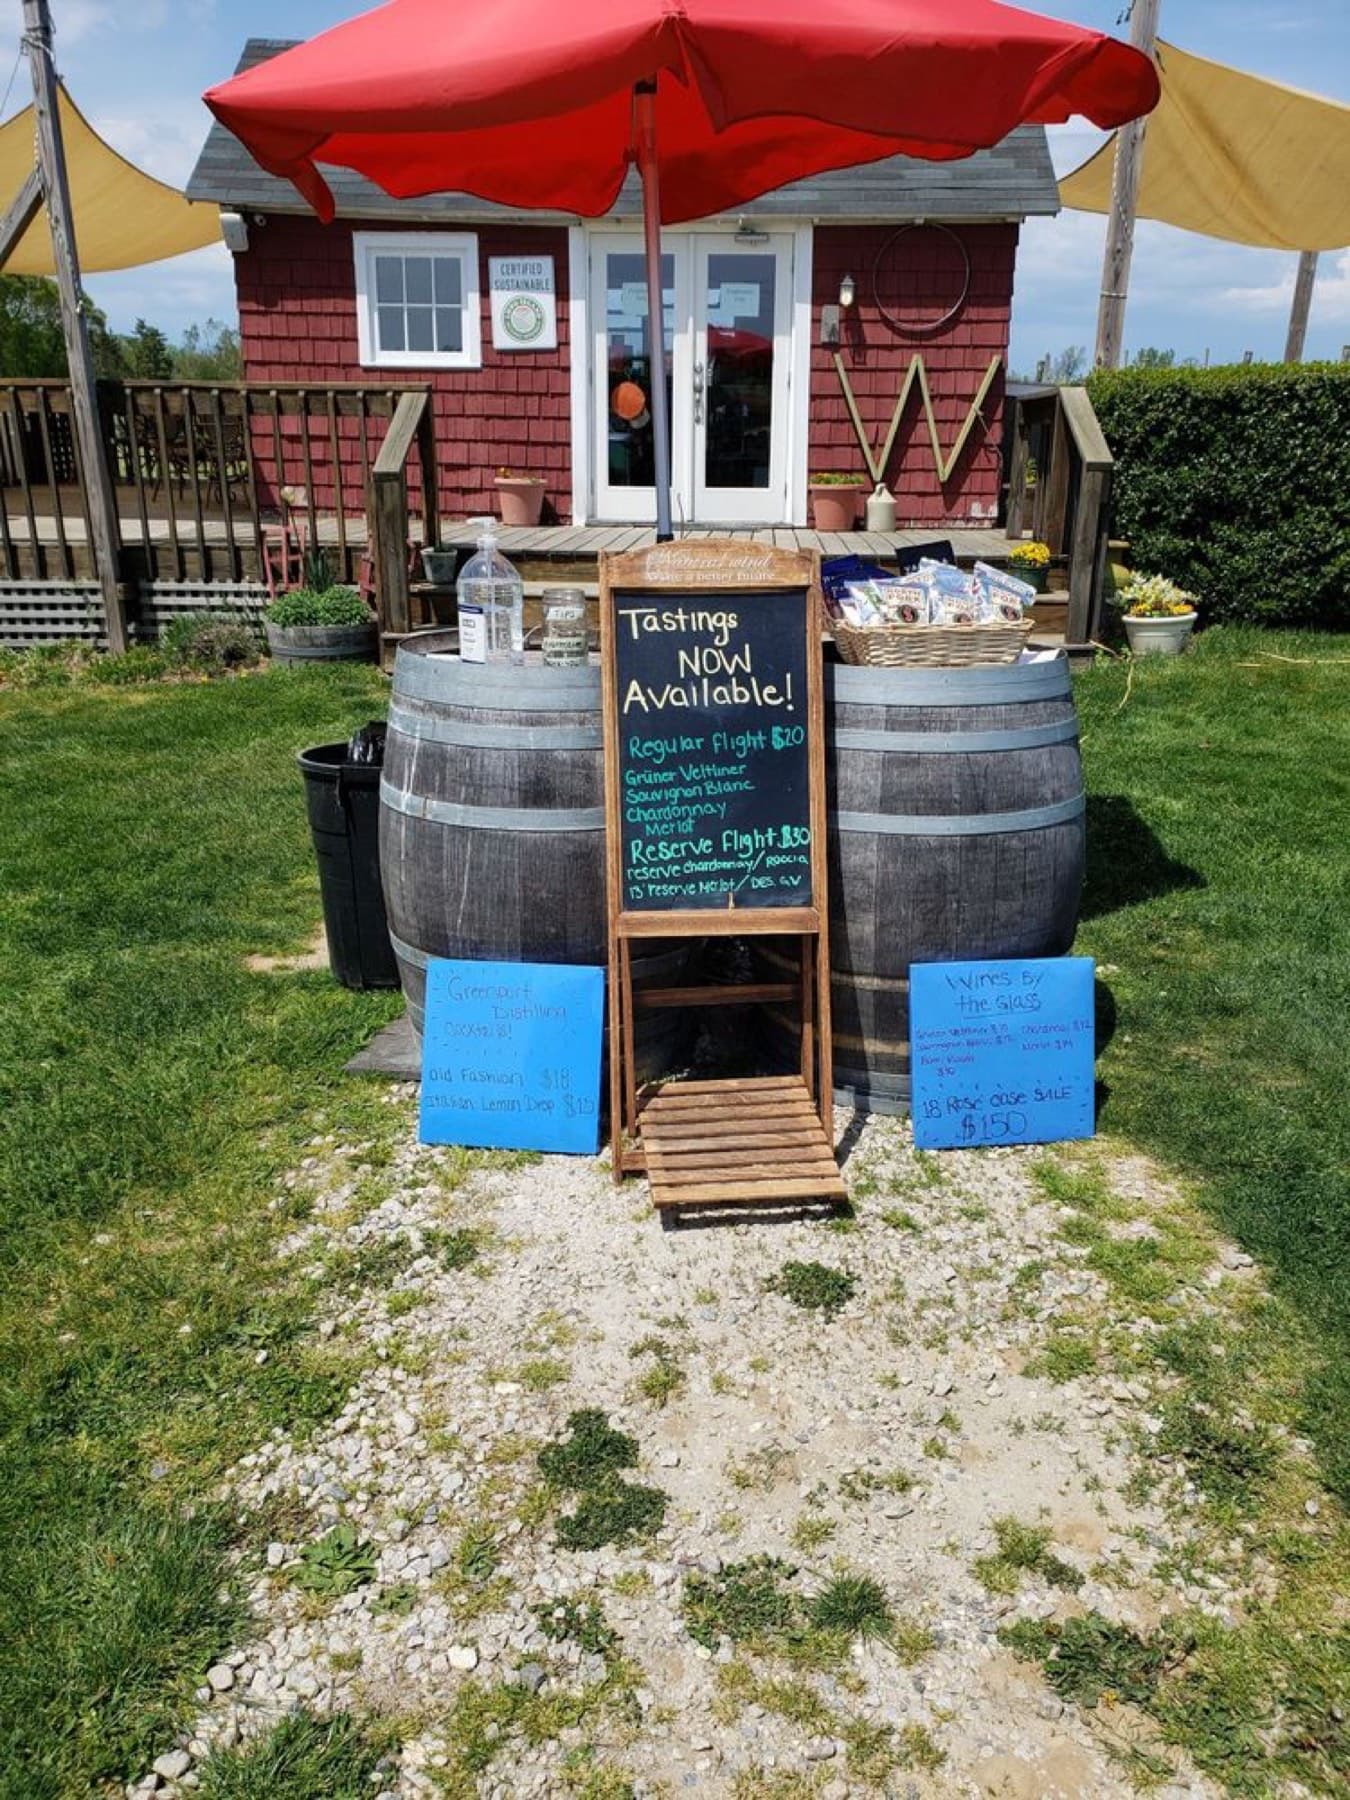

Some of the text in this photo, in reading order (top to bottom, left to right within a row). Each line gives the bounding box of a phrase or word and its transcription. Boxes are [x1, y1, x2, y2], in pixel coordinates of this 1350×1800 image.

[501, 263, 542, 275] CERTIFIED
[494, 278, 550, 290] SUSTAINABLE
[618, 608, 738, 646] Tastings
[678, 644, 752, 678] NOW
[623, 673, 795, 714] Available!
[629, 736, 704, 764] Regular
[771, 726, 804, 750] $20
[703, 779, 755, 795] Blanc
[645, 818, 695, 836] Merlot
[631, 837, 713, 864] Reserve
[777, 825, 811, 849] $30
[627, 864, 681, 880] reserve
[647, 881, 696, 897] reserve
[945, 971, 1013, 990] Wines
[956, 994, 990, 1014] the
[461, 1067, 525, 1087] Fashion
[955, 1110, 1028, 1141] $150
